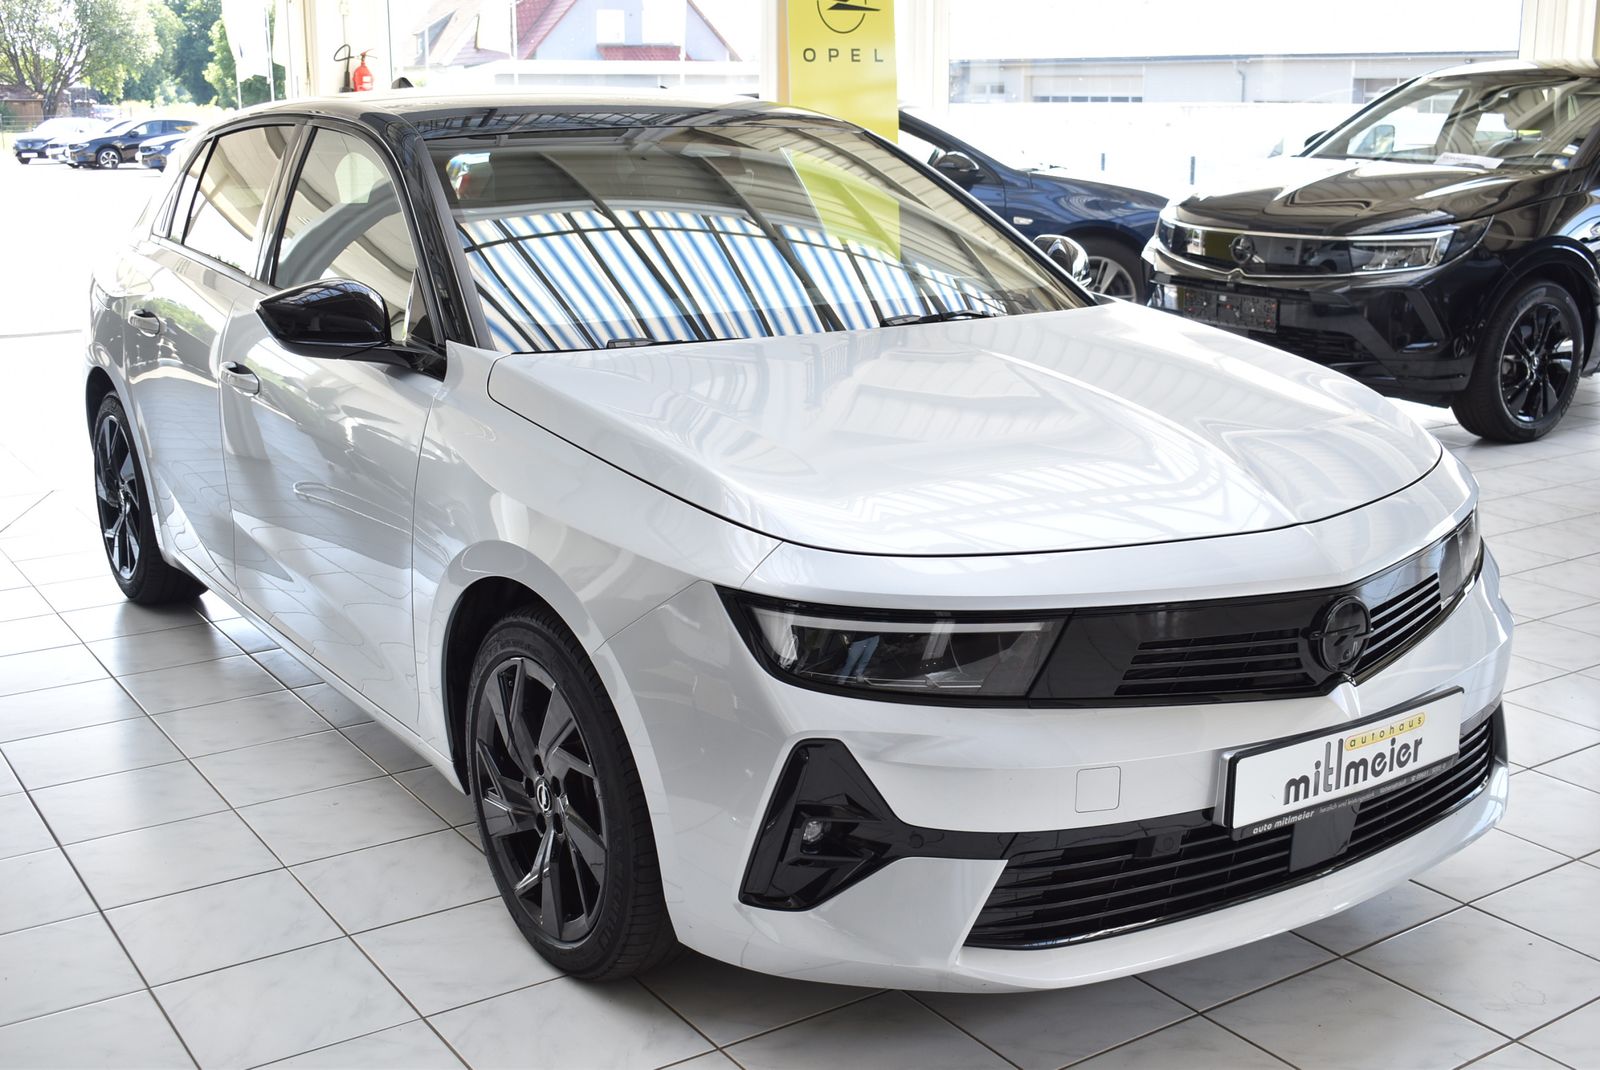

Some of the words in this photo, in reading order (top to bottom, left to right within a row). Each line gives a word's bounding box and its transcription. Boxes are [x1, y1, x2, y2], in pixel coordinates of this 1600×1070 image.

[803, 48, 884, 62] OPEL
[1349, 716, 1422, 747] autohaus
[1283, 737, 1423, 805] mitlmeier
[1253, 823, 1272, 834] auto
[1274, 810, 1315, 828] mitlmeier
